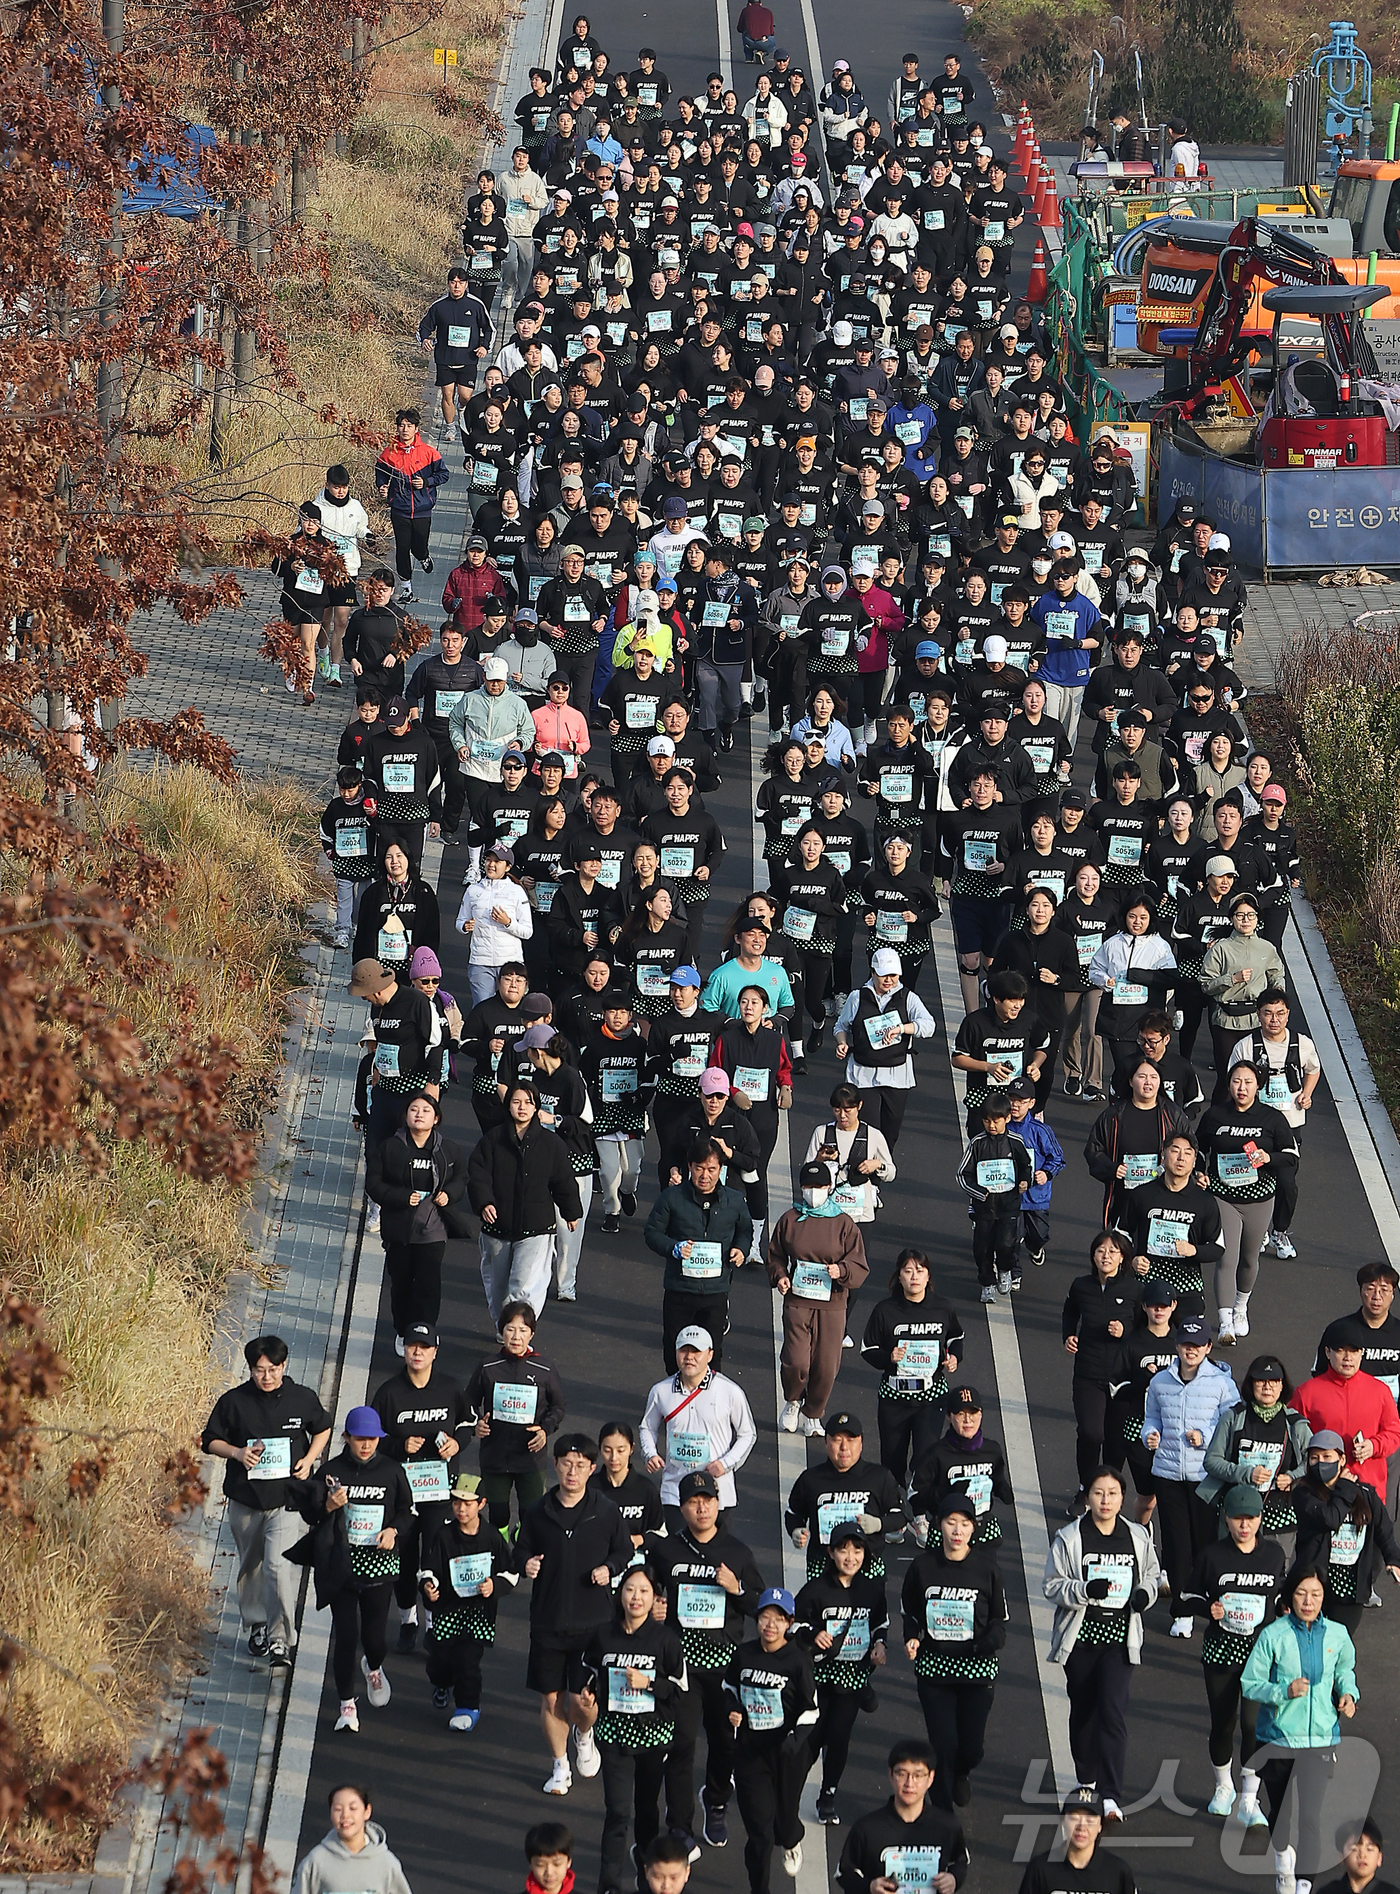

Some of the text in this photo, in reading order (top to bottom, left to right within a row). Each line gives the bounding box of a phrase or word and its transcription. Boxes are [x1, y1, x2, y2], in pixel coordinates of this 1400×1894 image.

[1150, 273, 1197, 295] DOOSAN
[1051, 458, 1070, 466] HAPPS
[724, 500, 745, 508] HAPPS
[1308, 508, 1354, 529] 안전
[1085, 542, 1106, 550] HAPPS
[999, 565, 1020, 574] HAPPS
[1210, 608, 1230, 616] HAPPS
[969, 617, 991, 626] HAPPS
[1010, 642, 1032, 650] HAPPS
[635, 695, 660, 703] HAPPS
[1032, 737, 1055, 745] HAPPS
[392, 754, 418, 762] HAPPS
[891, 764, 915, 774] HAPPS
[504, 810, 531, 818] HAPPS
[1116, 820, 1143, 829] HAPPS
[674, 834, 700, 843] HAPPS
[973, 831, 1000, 840] HAPPS
[826, 836, 852, 845] HAPPS
[1040, 870, 1065, 878] HAPPS
[800, 886, 826, 895] HAPPS
[1081, 921, 1106, 931] HAPPS
[649, 950, 675, 958] HAPPS
[381, 1019, 401, 1028] HAPPS
[684, 1033, 710, 1042] HAPPS
[997, 1038, 1025, 1048] HAPPS
[997, 1038, 1024, 1048] HAPPS
[610, 1057, 638, 1067] HAPPS
[1230, 1127, 1262, 1138] HAPPS
[1225, 1167, 1250, 1175] 55862
[986, 1173, 1007, 1181] 50122
[1162, 1209, 1195, 1223] HAPPS
[690, 1257, 714, 1265] 50059
[910, 1323, 942, 1334] HAPPS
[1365, 1349, 1400, 1361] HAPPS
[502, 1401, 526, 1410] 55184
[414, 1408, 448, 1422] HAPPS
[676, 1448, 702, 1458] 50485
[256, 1454, 282, 1465] 0500
[963, 1463, 993, 1476] HAPPS
[412, 1477, 439, 1487] 55606
[349, 1486, 386, 1499] HAPPS
[834, 1492, 870, 1504] HAPPS
[1100, 1554, 1134, 1566] HAPPS
[1237, 1573, 1274, 1587] HAPPS
[941, 1587, 979, 1601] HAPPS
[686, 1603, 715, 1612] 50229
[936, 1617, 964, 1626] 55522
[616, 1654, 656, 1668] HAPPS
[751, 1670, 789, 1688] HAPPS
